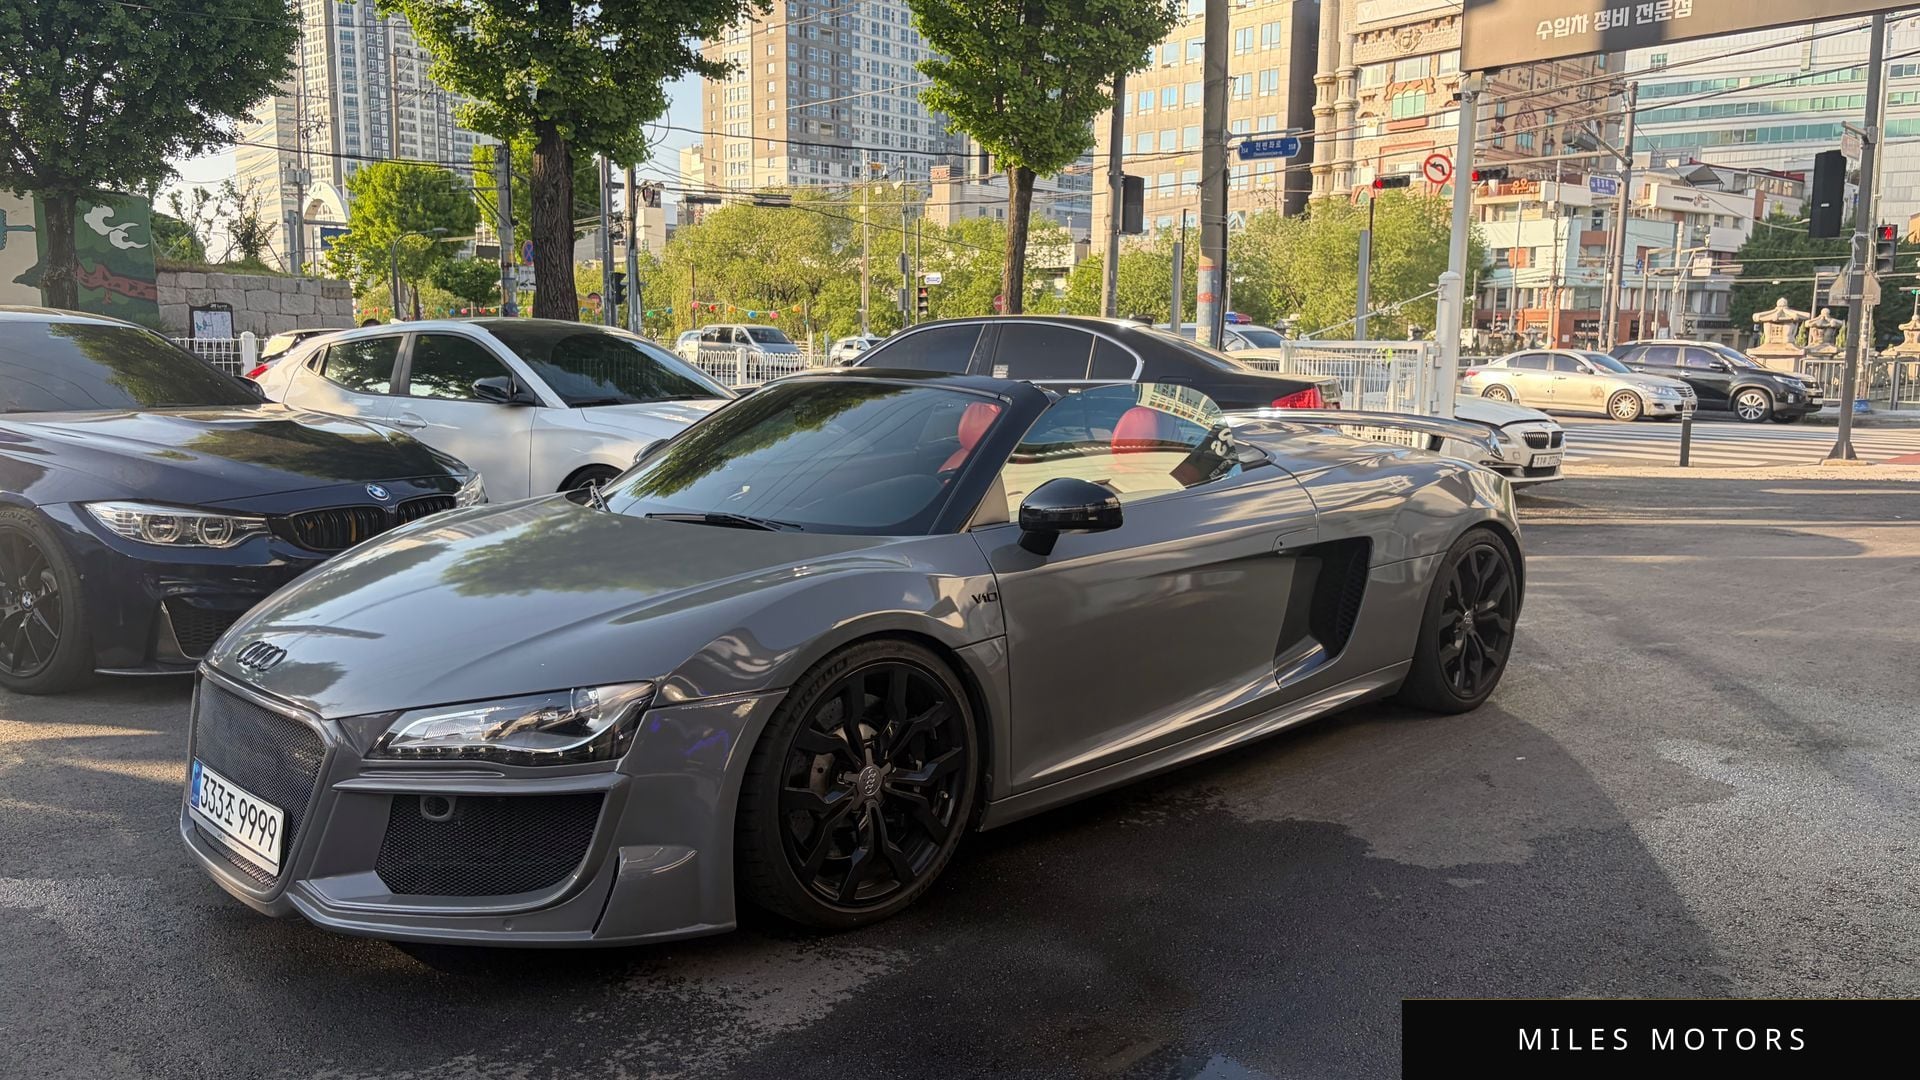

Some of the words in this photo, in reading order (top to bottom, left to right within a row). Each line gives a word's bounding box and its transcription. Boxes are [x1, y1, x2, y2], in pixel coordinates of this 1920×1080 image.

[1536, 13, 1589, 40] 수입차
[1594, 6, 1630, 31] 정비
[1635, 0, 1693, 24] 전문점
[971, 592, 999, 604] V10
[200, 773, 235, 827] 333조
[239, 798, 277, 853] 9999
